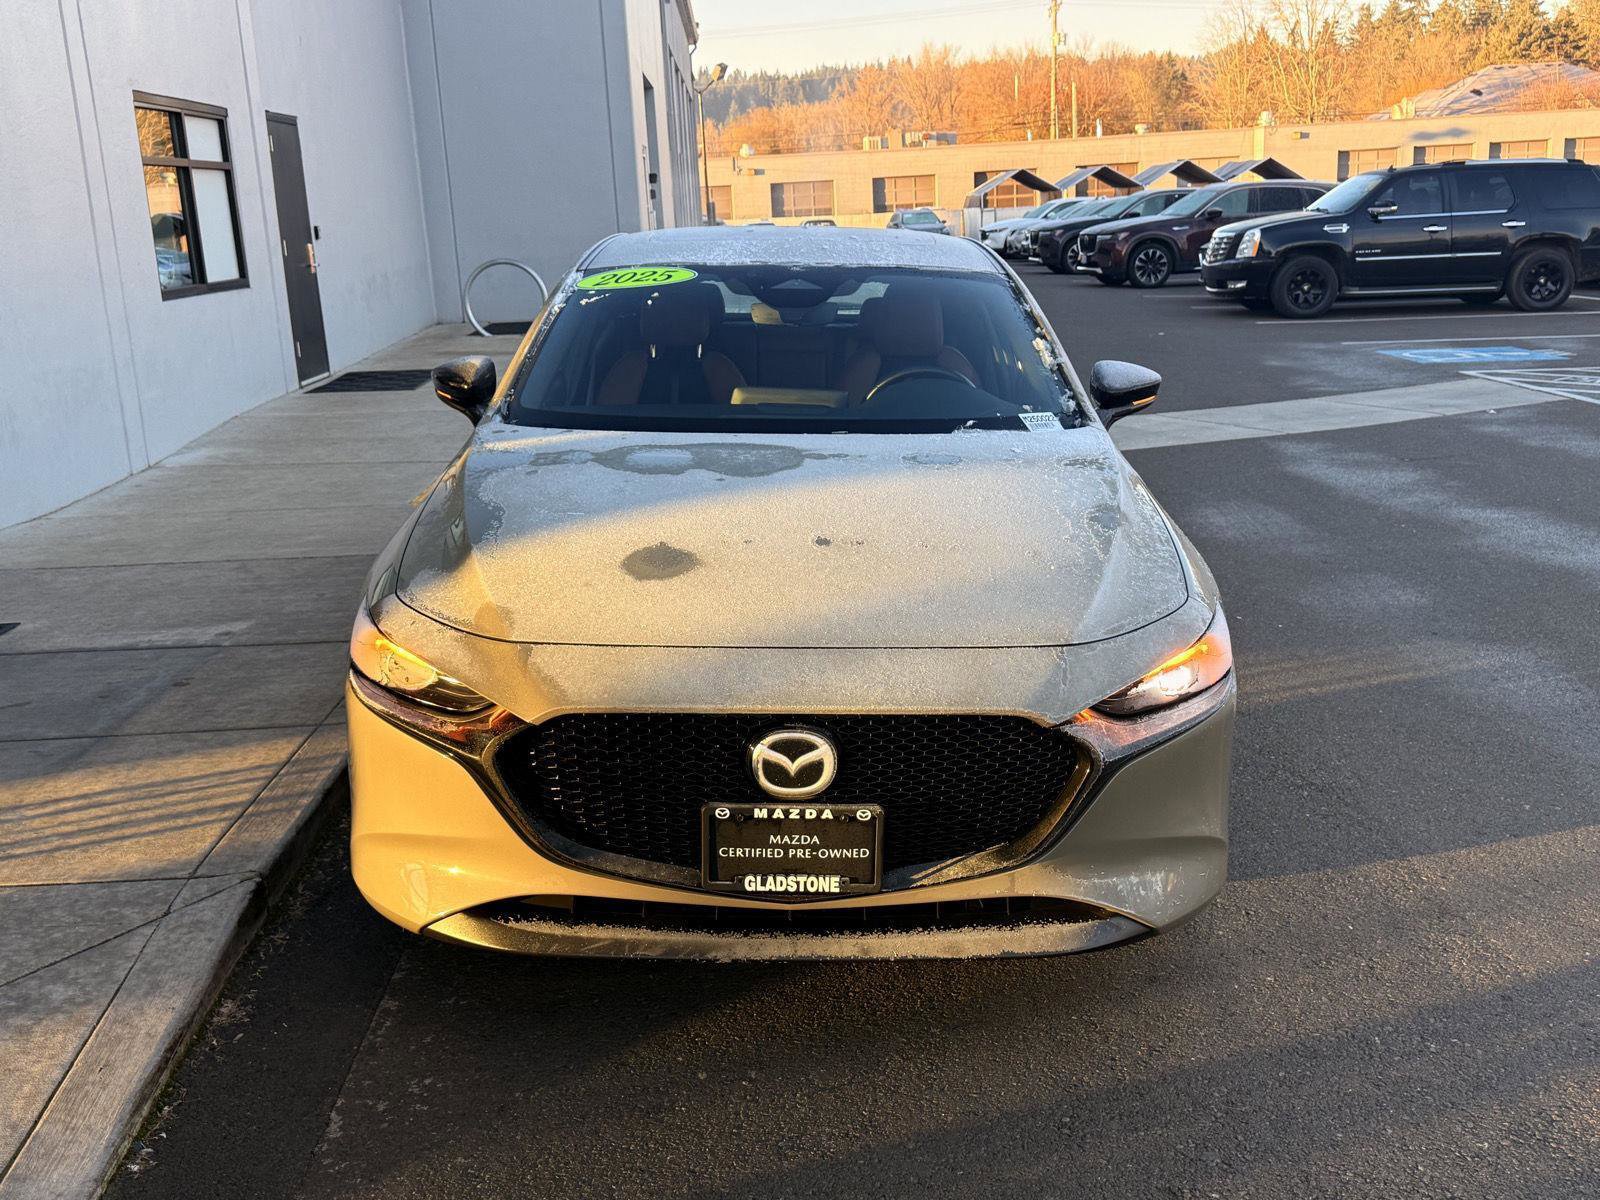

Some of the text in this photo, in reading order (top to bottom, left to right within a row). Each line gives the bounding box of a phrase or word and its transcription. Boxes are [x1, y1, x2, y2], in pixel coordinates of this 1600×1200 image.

[592, 270, 678, 286] 2025
[753, 808, 834, 819] MAZDA
[769, 835, 820, 845] MAZDA
[718, 847, 870, 858] CERTIFIED PRE-OWNED
[744, 875, 841, 892] GLADSTONE
